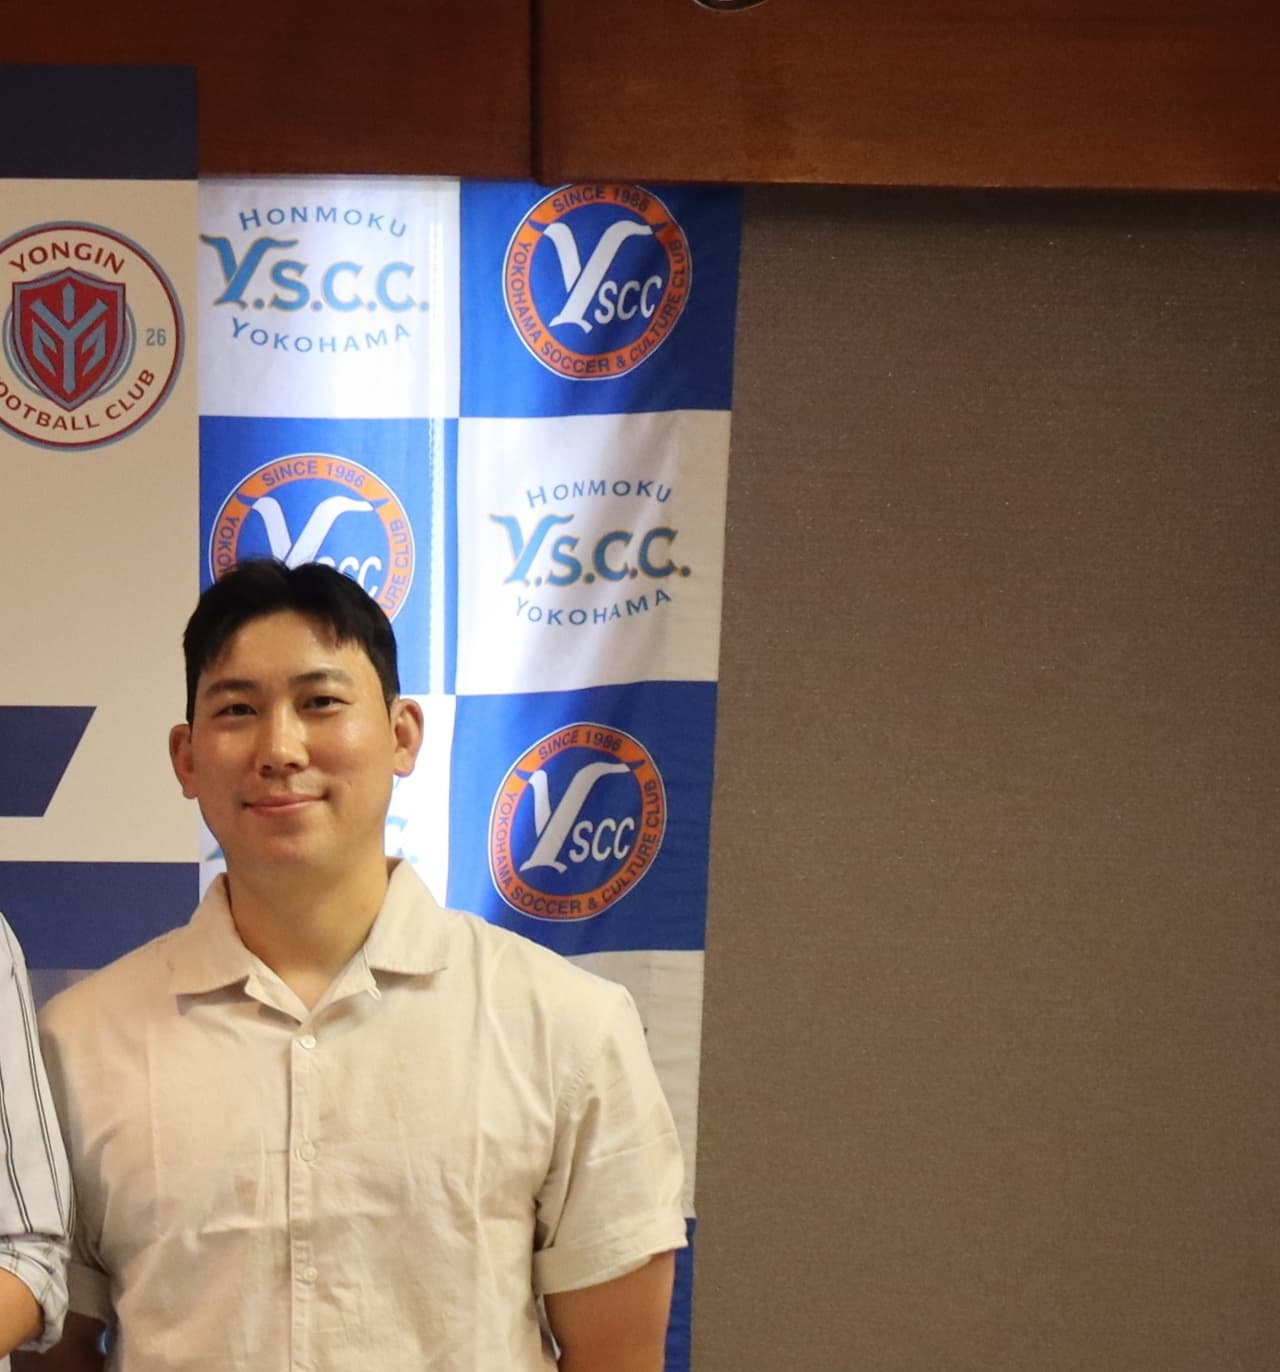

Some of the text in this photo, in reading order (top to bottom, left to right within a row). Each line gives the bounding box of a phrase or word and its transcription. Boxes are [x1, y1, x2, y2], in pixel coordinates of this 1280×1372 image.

[553, 186, 605, 212] SINCE
[239, 207, 407, 237] HONMOKU
[9, 242, 125, 274] YONGIN
[198, 233, 430, 312] Y.S.C.C.
[511, 241, 687, 373] YOKOHAMA SOCCER & CULTURE CLUB
[146, 328, 166, 346] 26
[232, 317, 410, 352] YOKOHAMA
[106, 369, 155, 420] CLUB
[262, 460, 365, 487] SINCE 1986
[526, 480, 672, 508] HONMOKU
[390, 519, 409, 568] CLUB
[488, 513, 691, 587] Y.S.C.C.
[516, 589, 672, 626] YOKOHAMA
[539, 730, 622, 760] SINCE 1986
[495, 779, 661, 914] YOKOHAMA SOCCER & CULTURE CLUB
